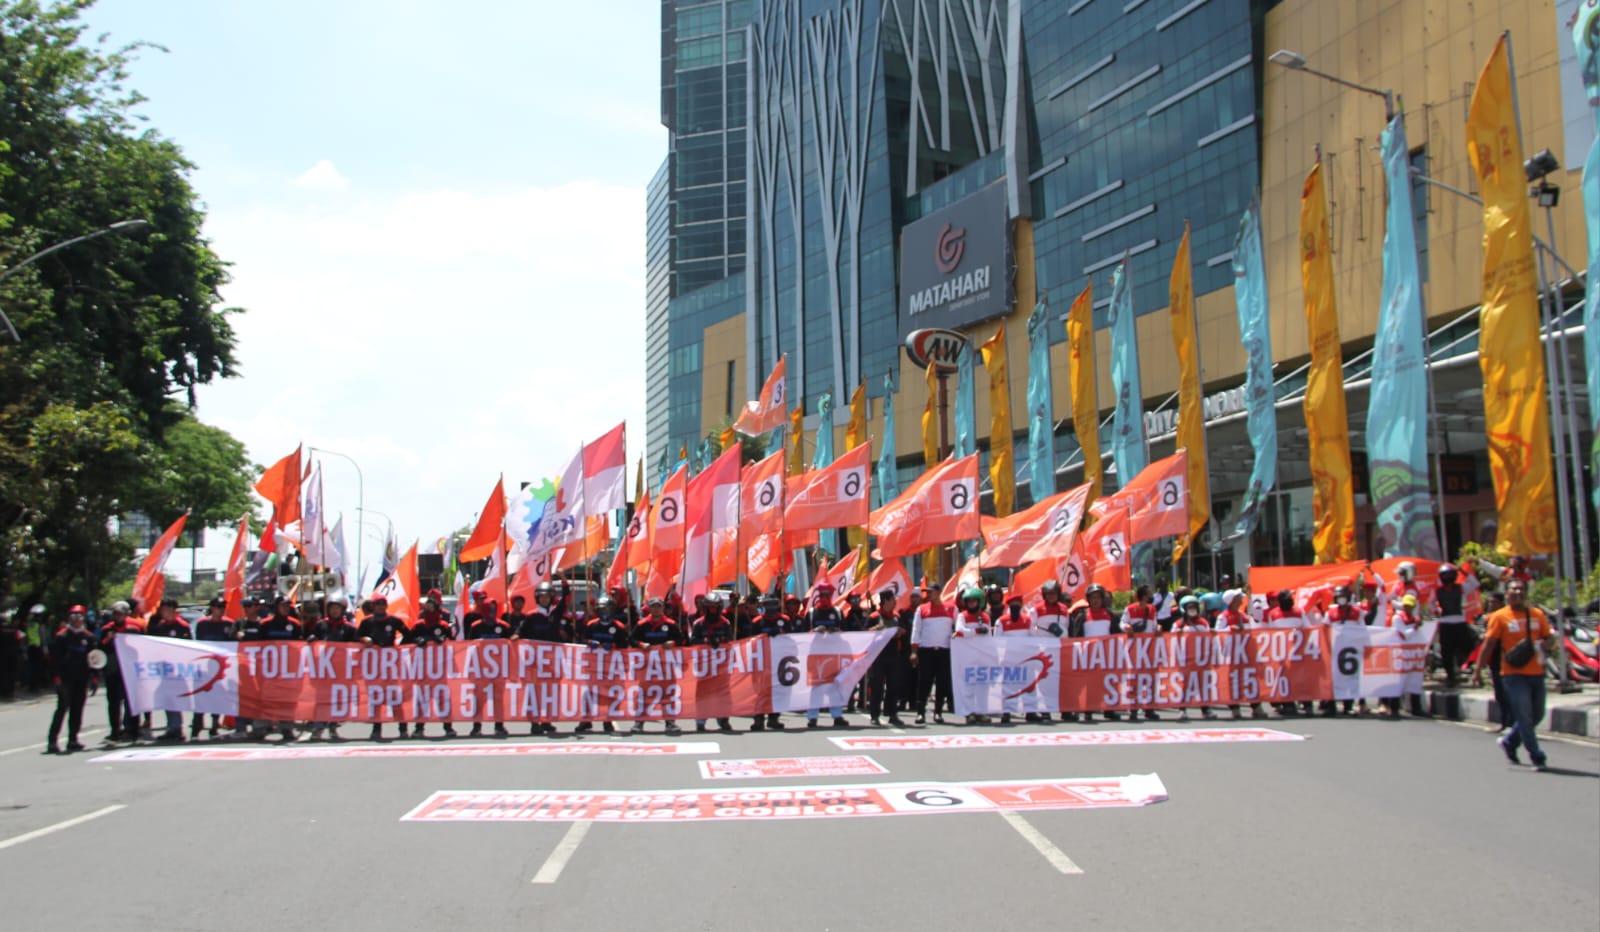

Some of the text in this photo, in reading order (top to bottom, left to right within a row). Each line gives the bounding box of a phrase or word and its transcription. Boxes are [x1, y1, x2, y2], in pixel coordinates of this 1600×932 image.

[909, 265, 990, 316] MATAHARI
[244, 638, 764, 681] TOLAK FORMULASI PENETAPAN UPAH
[1071, 629, 1321, 671] NAIKKAN UMK 2024
[1337, 646, 1359, 676] 6
[133, 661, 203, 678] FSPMI
[777, 655, 801, 687] 6
[964, 665, 1028, 682] FSPMI
[1103, 665, 1290, 705] SEBESAR 15 %
[331, 683, 358, 718] DI
[367, 684, 404, 718] PP
[412, 683, 450, 718] NO
[505, 682, 598, 718] TAHUN
[608, 684, 683, 718] 2023
[711, 788, 869, 801] COBLOS
[904, 788, 964, 807] 6
[426, 804, 884, 819] PEMILU 2024 COBLOS
